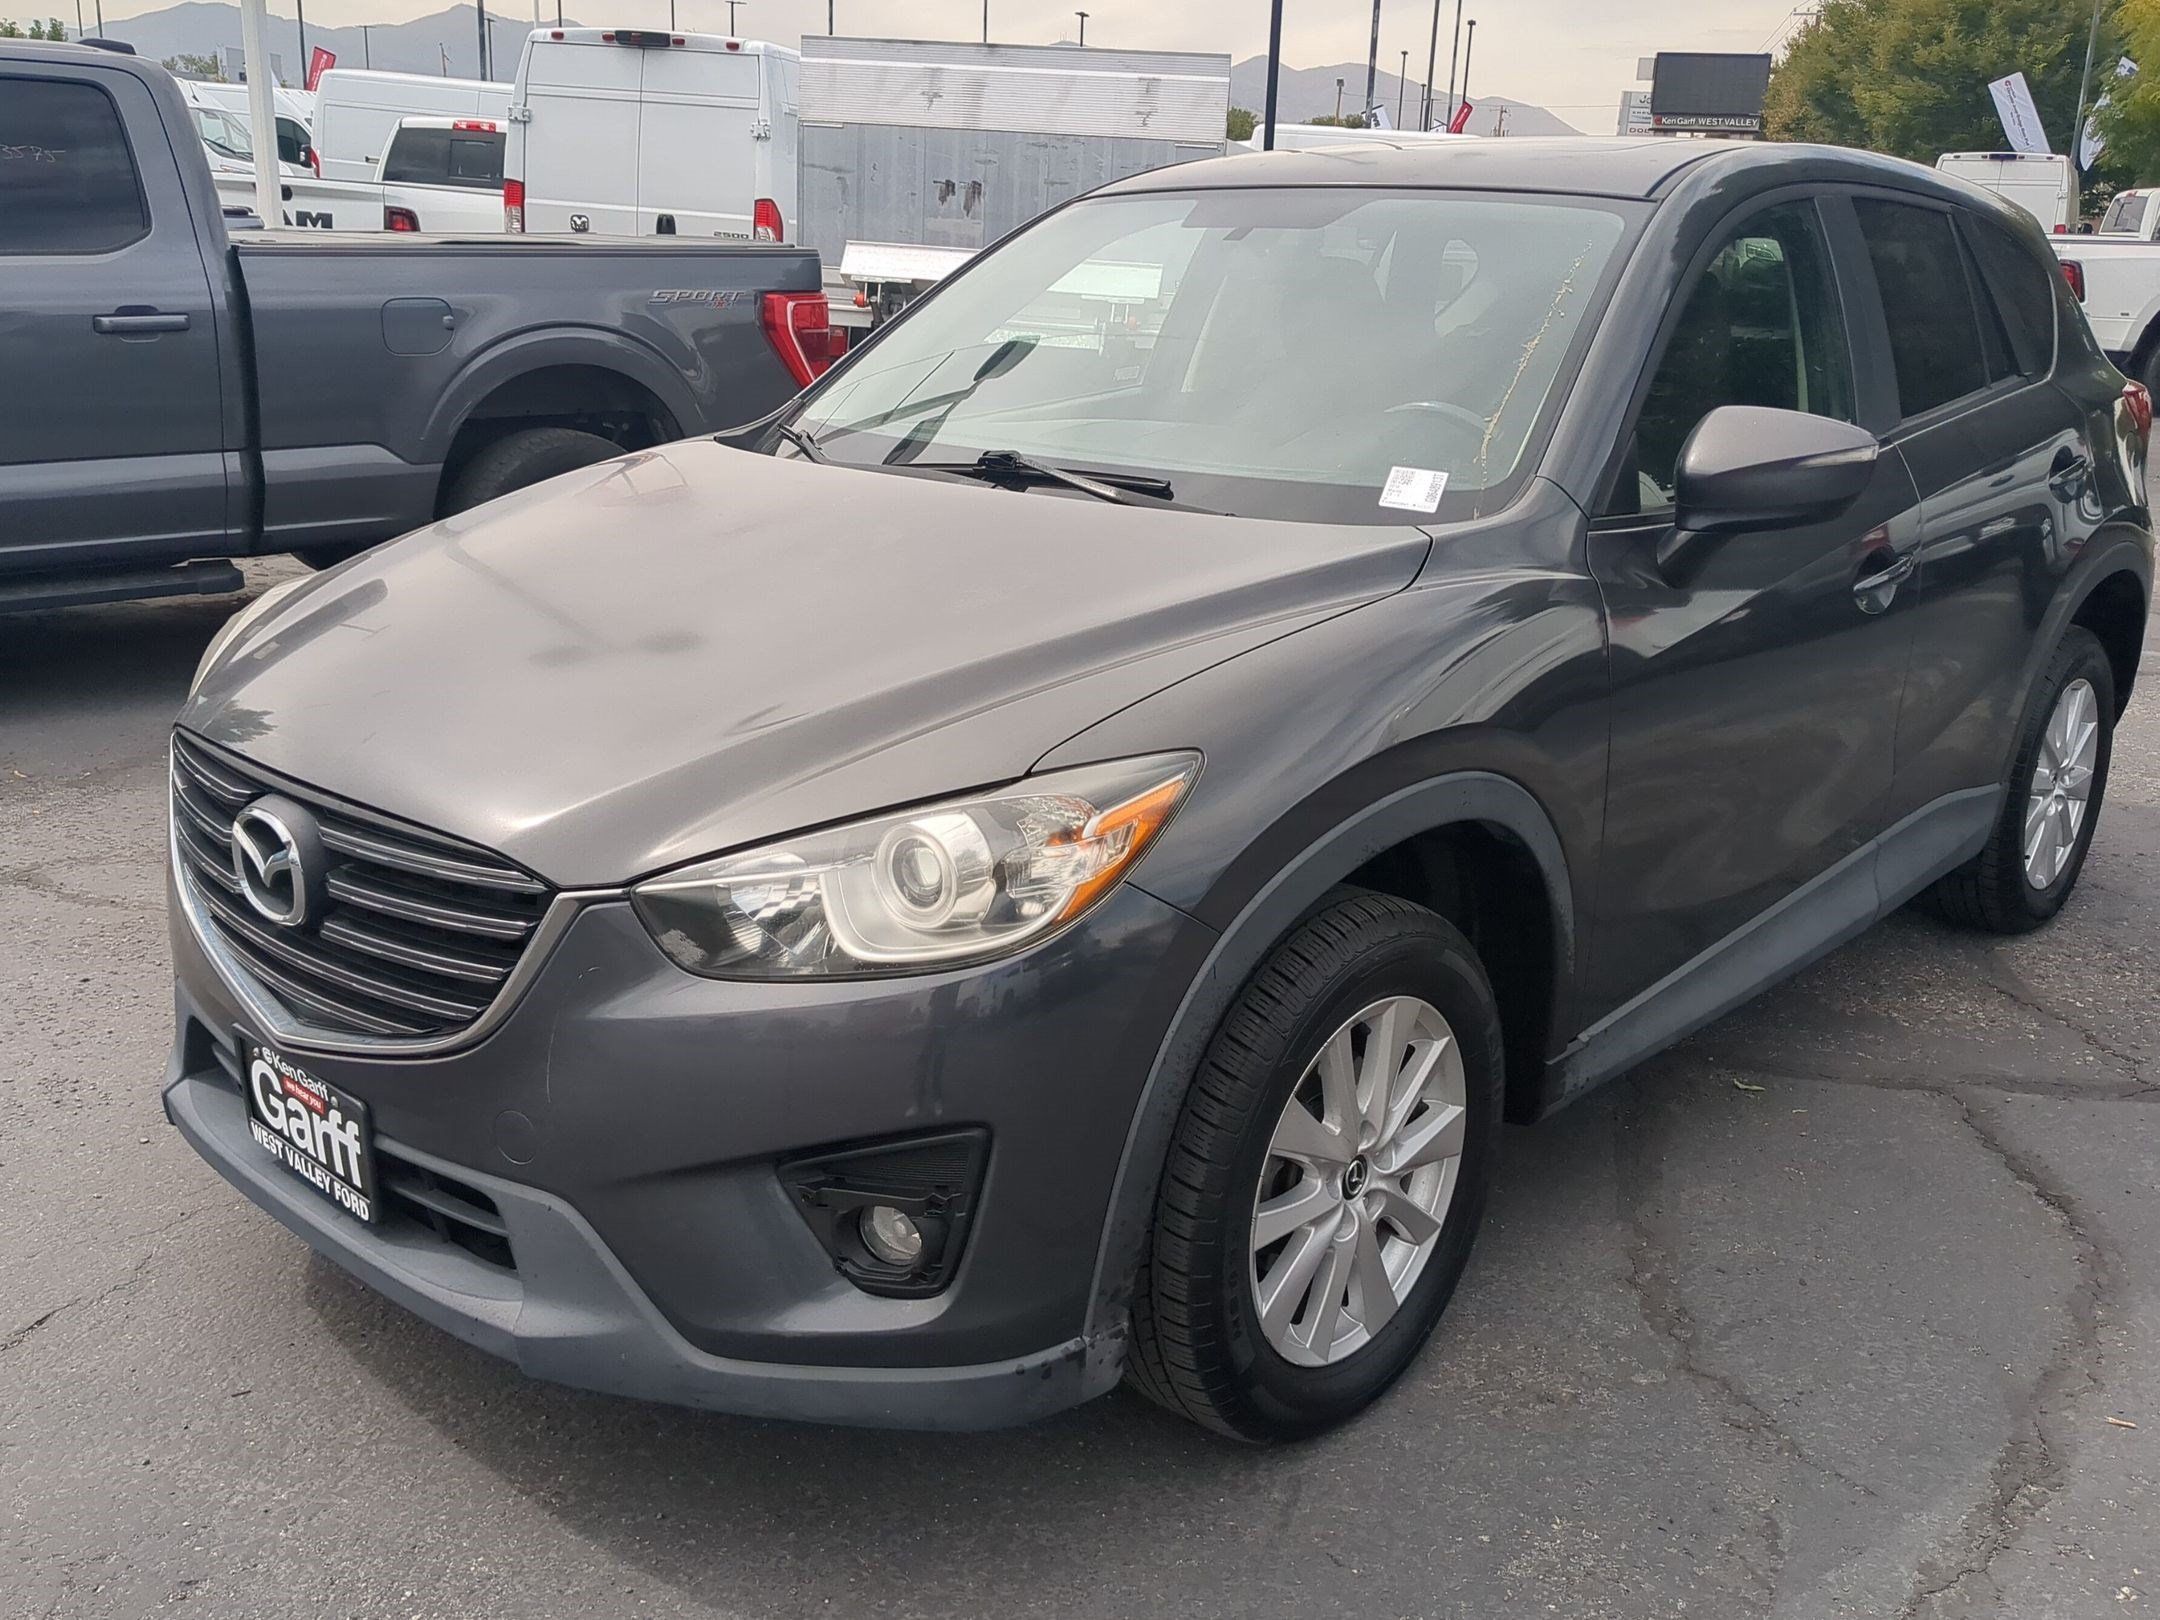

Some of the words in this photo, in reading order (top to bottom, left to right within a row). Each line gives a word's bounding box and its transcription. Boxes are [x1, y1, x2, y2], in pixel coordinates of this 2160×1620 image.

[1698, 118, 1723, 126] WEST
[1724, 118, 1758, 127] VALLEY
[648, 289, 745, 305] SPORT
[310, 1096, 322, 1110] you
[251, 1059, 363, 1189] Garff
[251, 1121, 284, 1160] WEST
[285, 1145, 331, 1195] VALLEY
[334, 1181, 370, 1221] FORD
